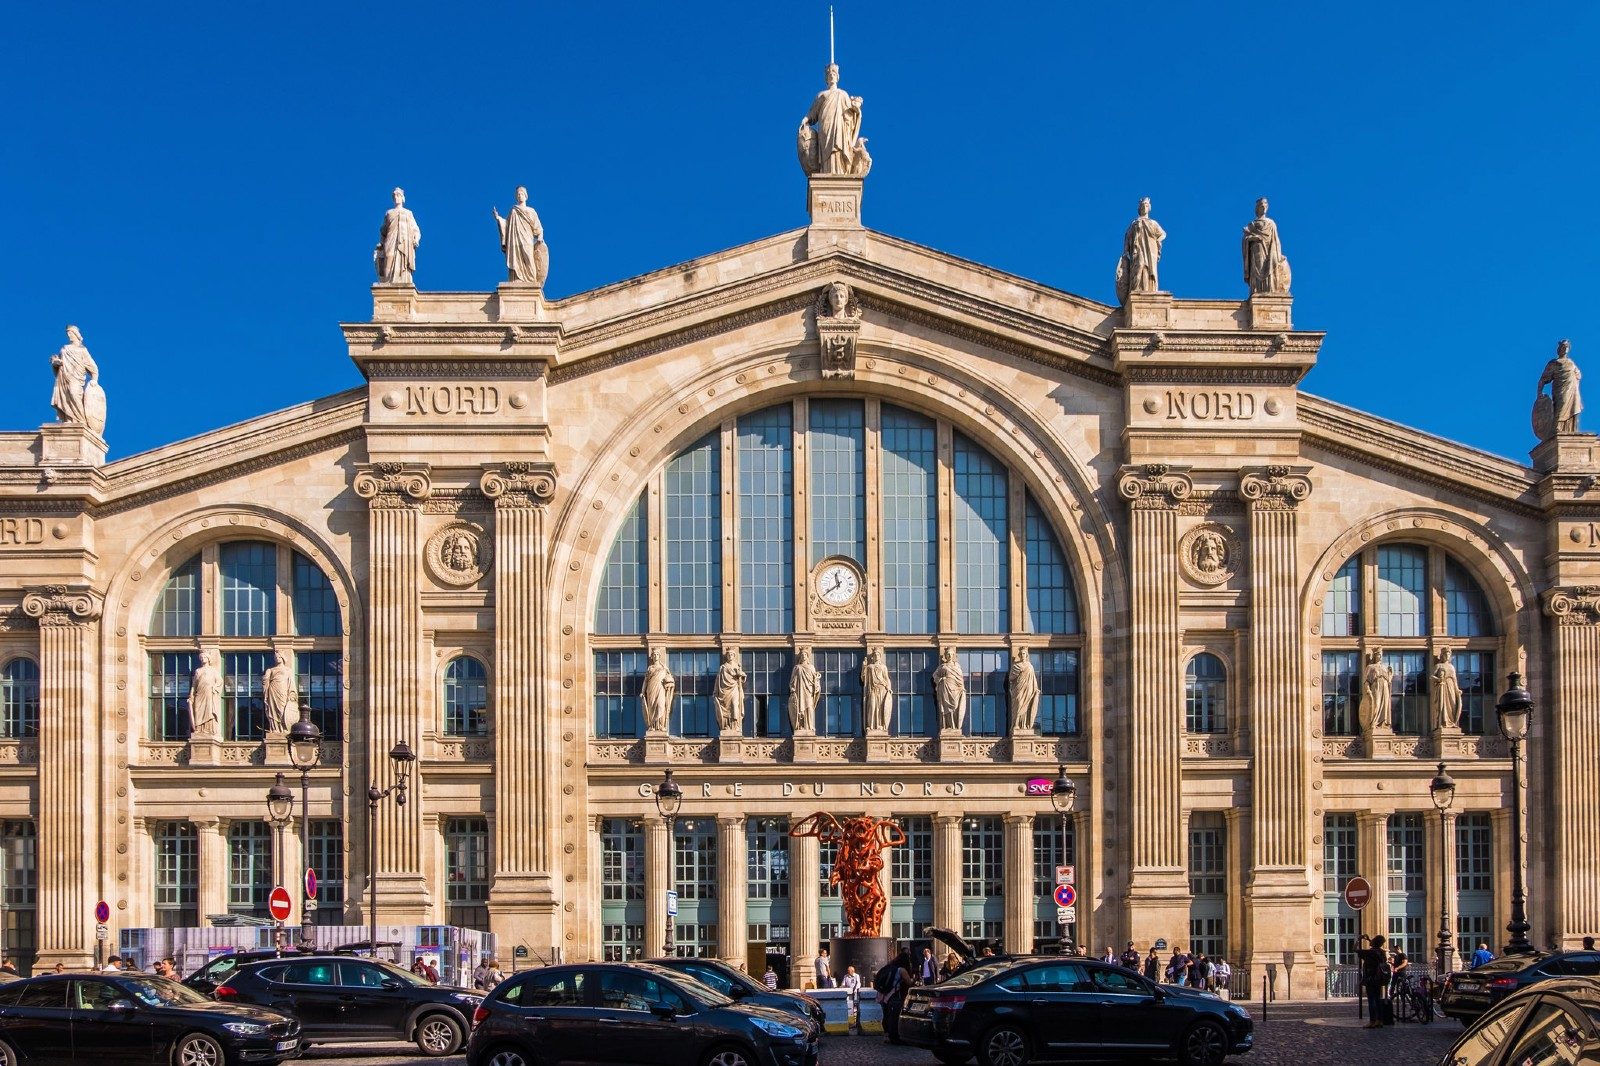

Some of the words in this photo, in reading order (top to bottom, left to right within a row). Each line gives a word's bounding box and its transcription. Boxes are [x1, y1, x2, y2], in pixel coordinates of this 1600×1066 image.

[821, 201, 853, 213] PARIS
[405, 386, 500, 416] NORD
[1165, 391, 1255, 420] NORD
[638, 782, 744, 797] GRE
[782, 782, 825, 796] DU
[860, 781, 964, 796] NORD
